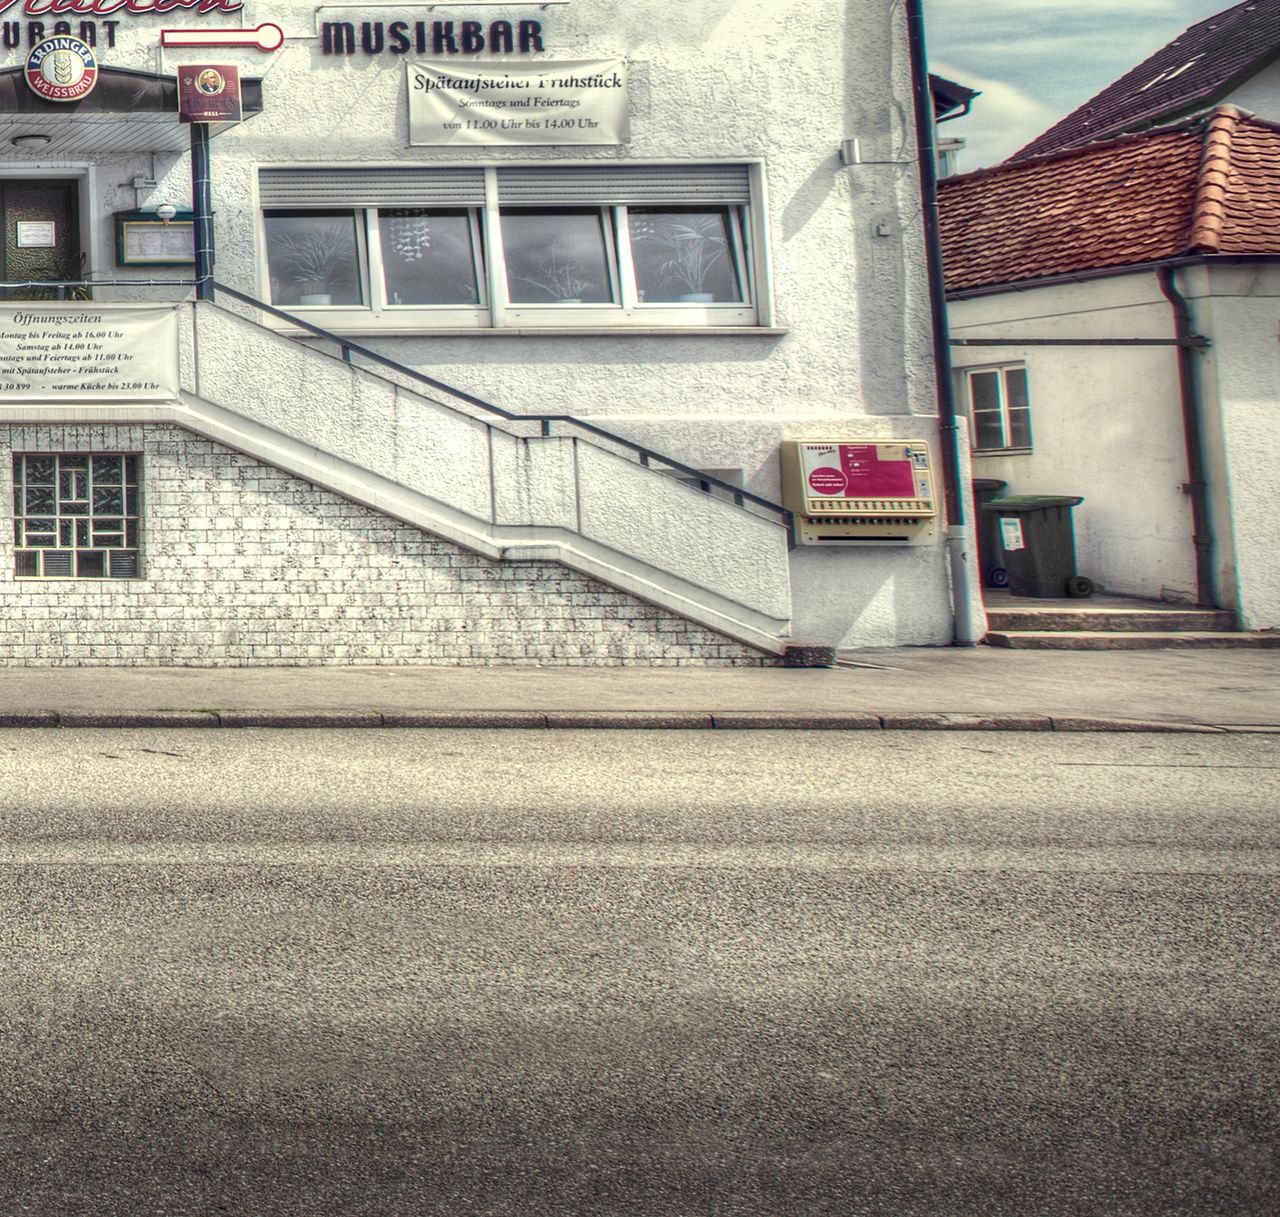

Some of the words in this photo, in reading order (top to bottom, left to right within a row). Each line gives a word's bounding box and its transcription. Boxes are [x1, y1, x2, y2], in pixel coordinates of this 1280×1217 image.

[322, 19, 545, 54] MUSIKBAR
[30, 38, 92, 64] ERDINGER
[458, 97, 507, 109] Sonntags
[509, 97, 530, 108] und
[533, 97, 581, 108] Feiertags
[443, 122, 462, 130] von
[466, 119, 497, 130] 11.00
[501, 119, 524, 130] Uhr
[525, 119, 540, 129] bis
[544, 119, 575, 130] 14.00
[578, 119, 599, 129] Uhr
[13, 312, 102, 326] Öffnungszeiten
[28, 331, 40, 339] bis
[42, 331, 71, 340] Freitag
[72, 331, 83, 339] ab
[85, 331, 106, 339] 16.00
[16, 344, 50, 352] Samstag
[63, 343, 85, 351] 14.00
[87, 343, 103, 351] Uhr
[43, 354, 80, 362] Feiertags
[94, 353, 116, 361] 11.00
[117, 353, 134, 361] Uhr
[16, 367, 71, 375] Spätaufsteher
[78, 366, 119, 374] Frühstück
